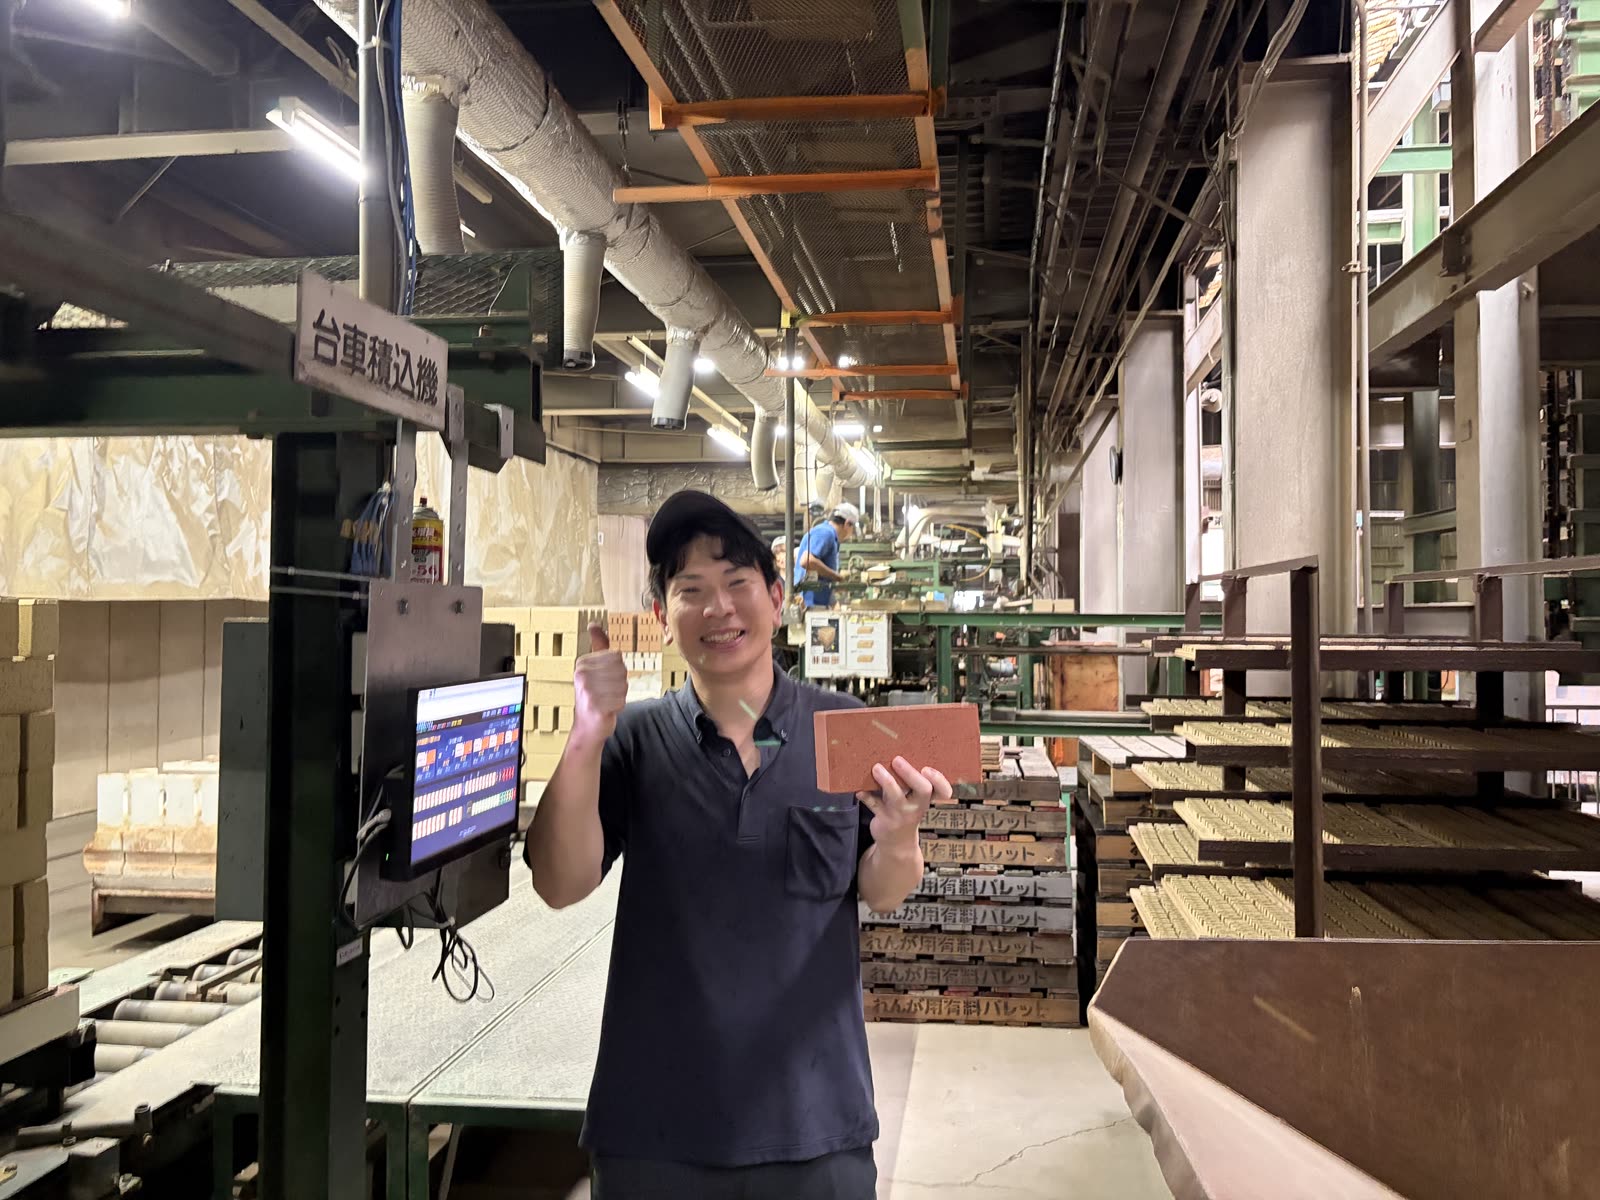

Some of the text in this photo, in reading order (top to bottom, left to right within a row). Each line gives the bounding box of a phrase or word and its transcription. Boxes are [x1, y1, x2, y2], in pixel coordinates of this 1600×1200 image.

[313, 308, 438, 406] 台車積込機
[917, 877, 1047, 898] 用有料パレット
[865, 934, 1043, 955] れんが用有料パレット
[871, 965, 1047, 985] れんが用有料パレット
[873, 998, 1047, 1018] れんが用有料パレット
